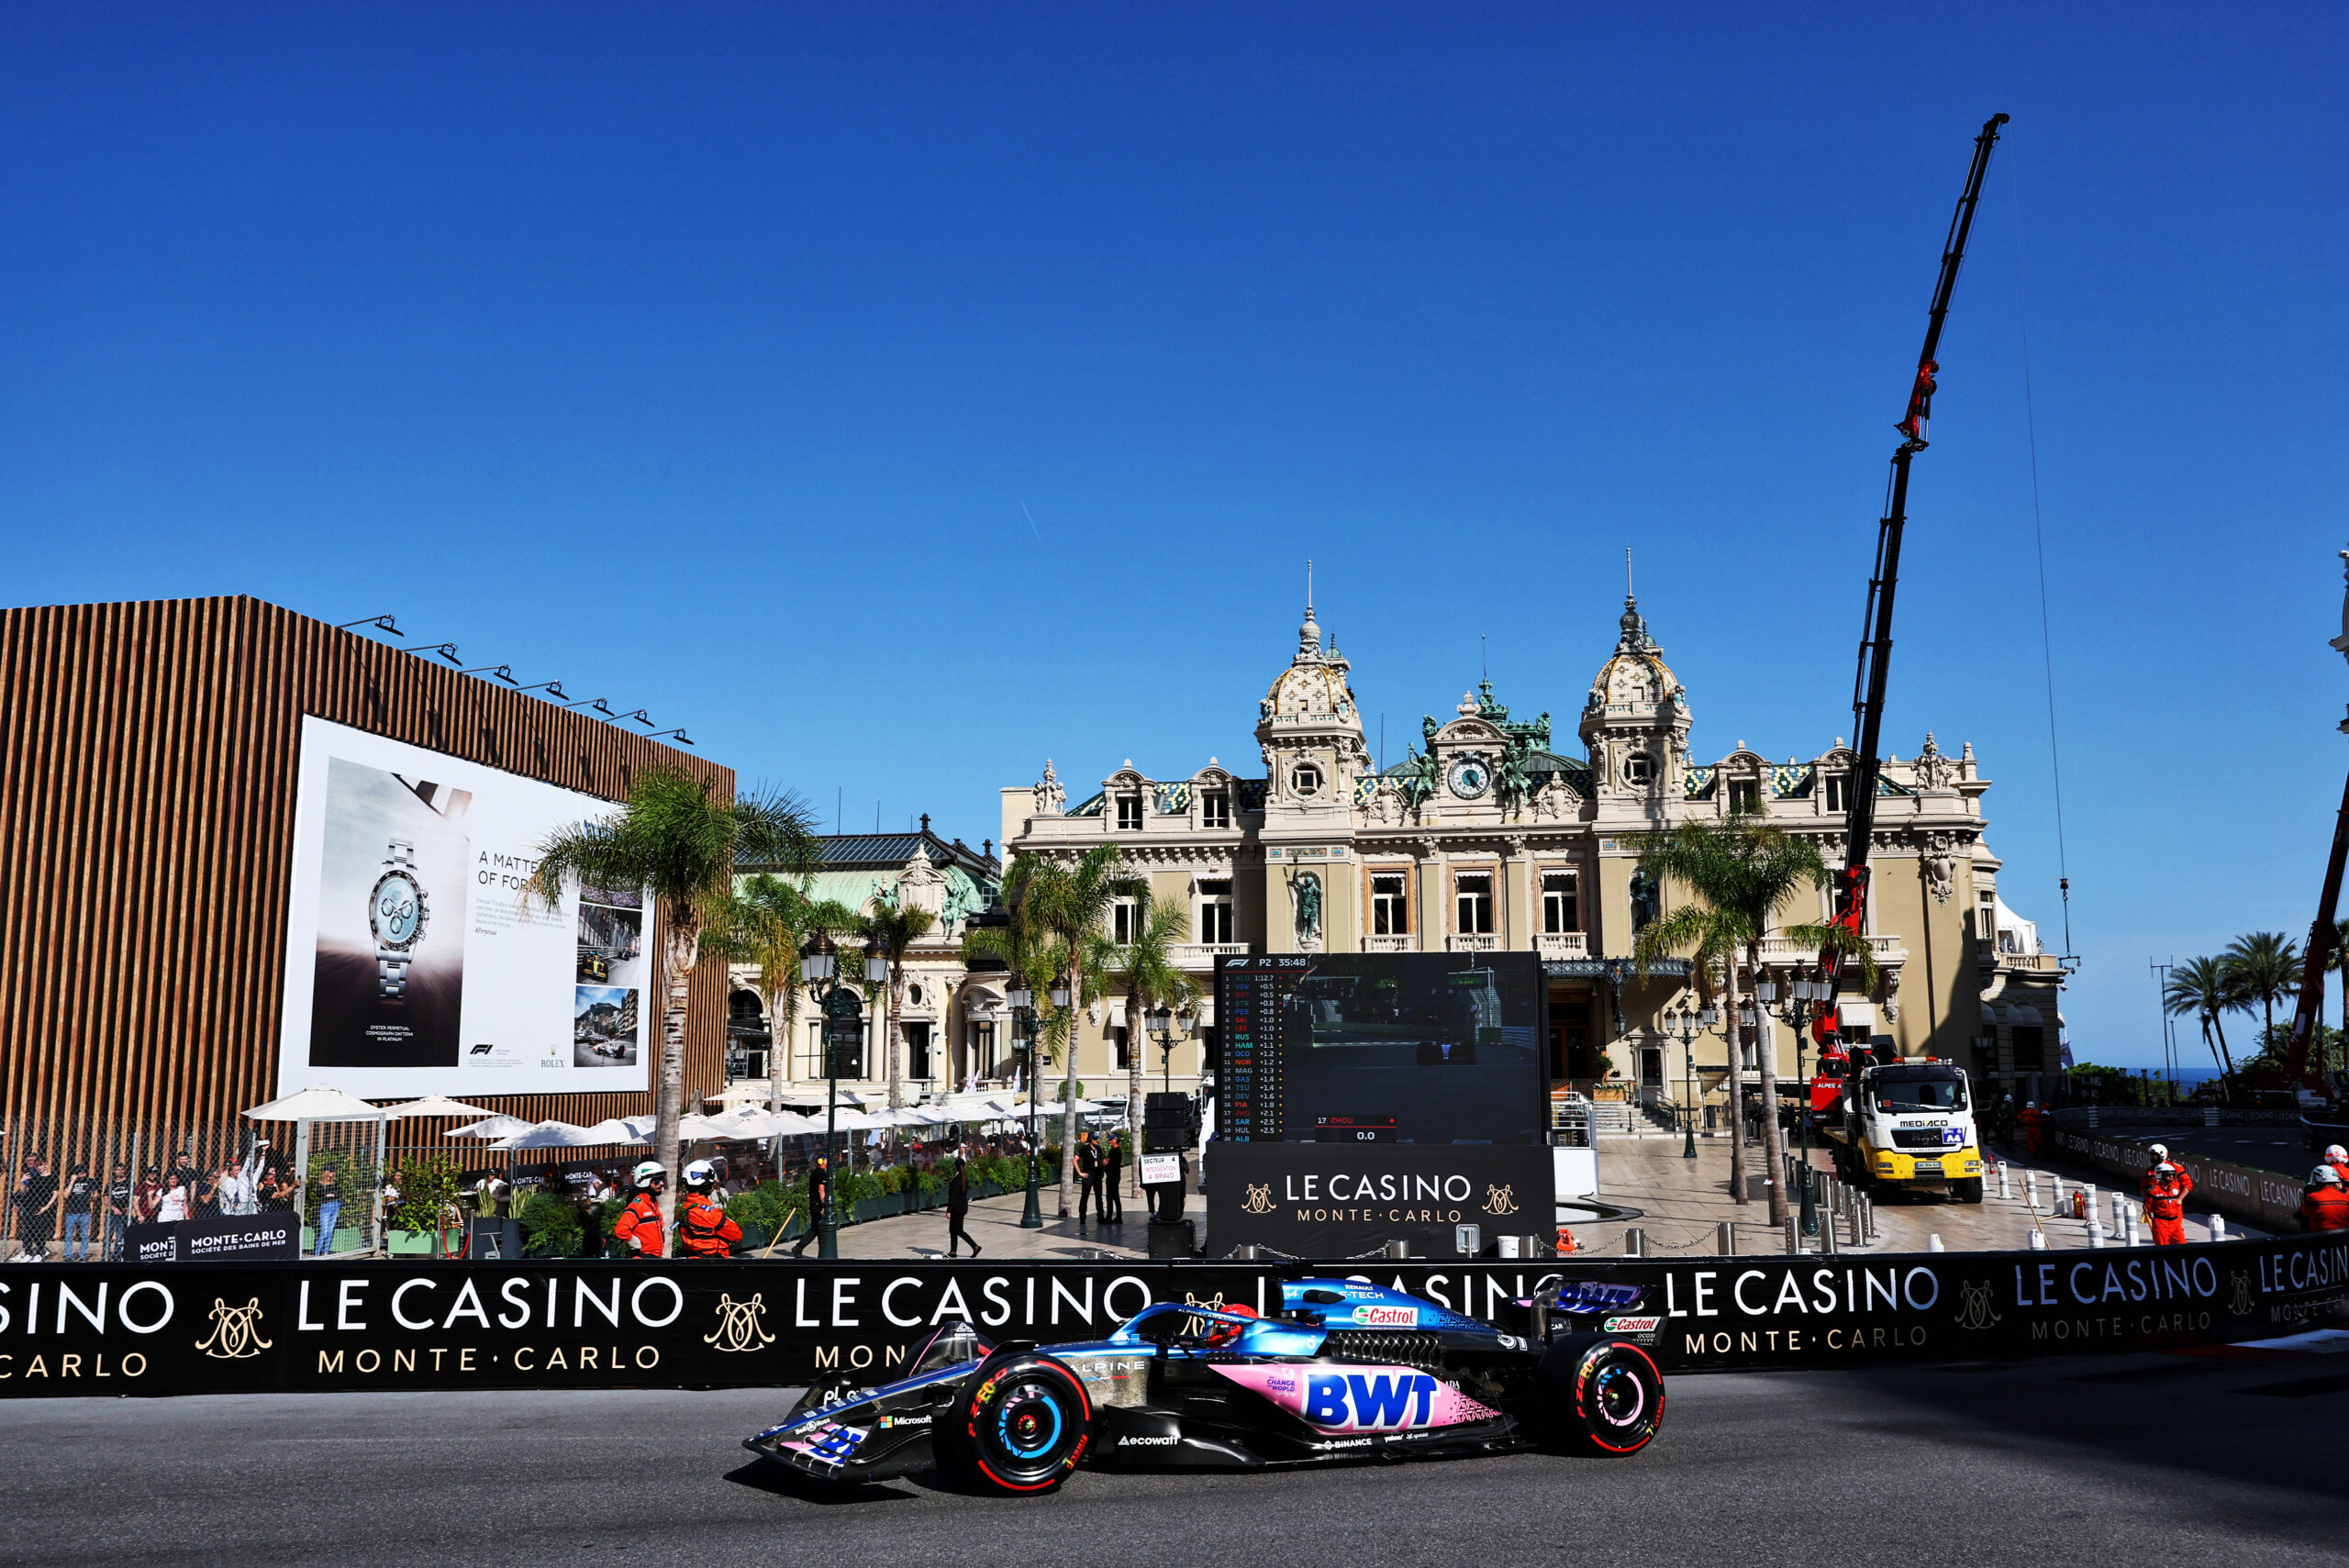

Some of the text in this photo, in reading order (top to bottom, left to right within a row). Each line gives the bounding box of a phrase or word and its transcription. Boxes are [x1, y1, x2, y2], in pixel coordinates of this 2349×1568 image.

[479, 851, 539, 873] A MATTE
[478, 871, 497, 884] OF
[1259, 959, 1272, 967] P2
[1278, 959, 1307, 967] 35:48
[1357, 1131, 1375, 1140] 0.0
[1286, 1173, 1471, 1202] LE CASINO
[2210, 1168, 2249, 1196] LE CASINO
[2260, 1180, 2270, 1202] LE
[2260, 1244, 2349, 1292] LE CASIN
[1666, 1267, 1939, 1317] LE CASINO
[2016, 1257, 2217, 1306] LE CASINO
[298, 1276, 684, 1331] LE CASINO
[796, 1276, 1152, 1328] LE CASINO
[1369, 1308, 1414, 1324] Castrol
[1617, 1318, 1655, 1331] Castrol
[1267, 1378, 1296, 1386] CHANGE
[1305, 1374, 1438, 1427] BWT
[894, 1415, 932, 1426] Microsoft
[1130, 1435, 1178, 1446] ecowatt
[1334, 1438, 1373, 1448] BINANCE
